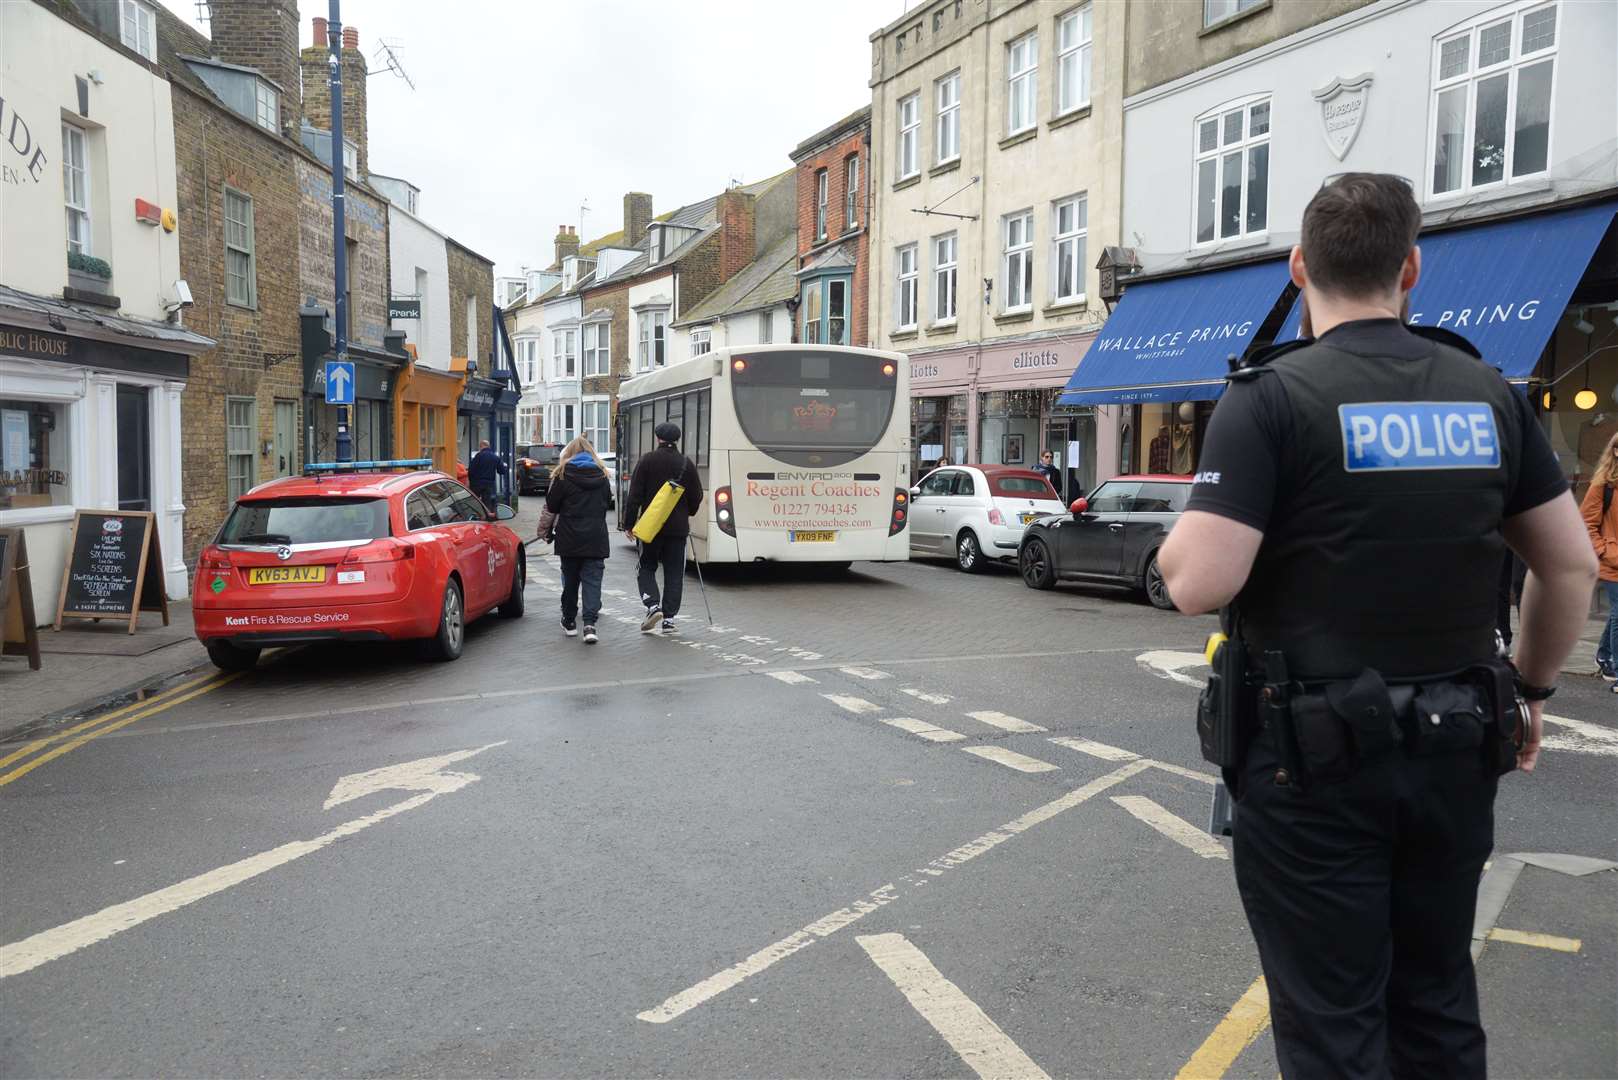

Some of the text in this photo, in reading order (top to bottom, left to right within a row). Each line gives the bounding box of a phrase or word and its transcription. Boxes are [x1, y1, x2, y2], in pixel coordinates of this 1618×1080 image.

[390, 309, 418, 318] Frank
[1437, 300, 1540, 328] PRING
[1098, 321, 1253, 352] WALLACE PRING
[1013, 350, 1058, 369] elliotts
[1135, 348, 1186, 360] WHITSTABLE
[1351, 413, 1494, 459] POLICE
[746, 481, 880, 501] Regent Coaches
[773, 504, 857, 516] 01227 794345
[754, 518, 872, 529] www.regentcoaches.com
[89, 551, 126, 559] SIX NATIONS
[97, 565, 122, 573] SCREENS
[293, 567, 320, 580] AVJ
[225, 612, 349, 625] Kent Fire & Rescue Service
